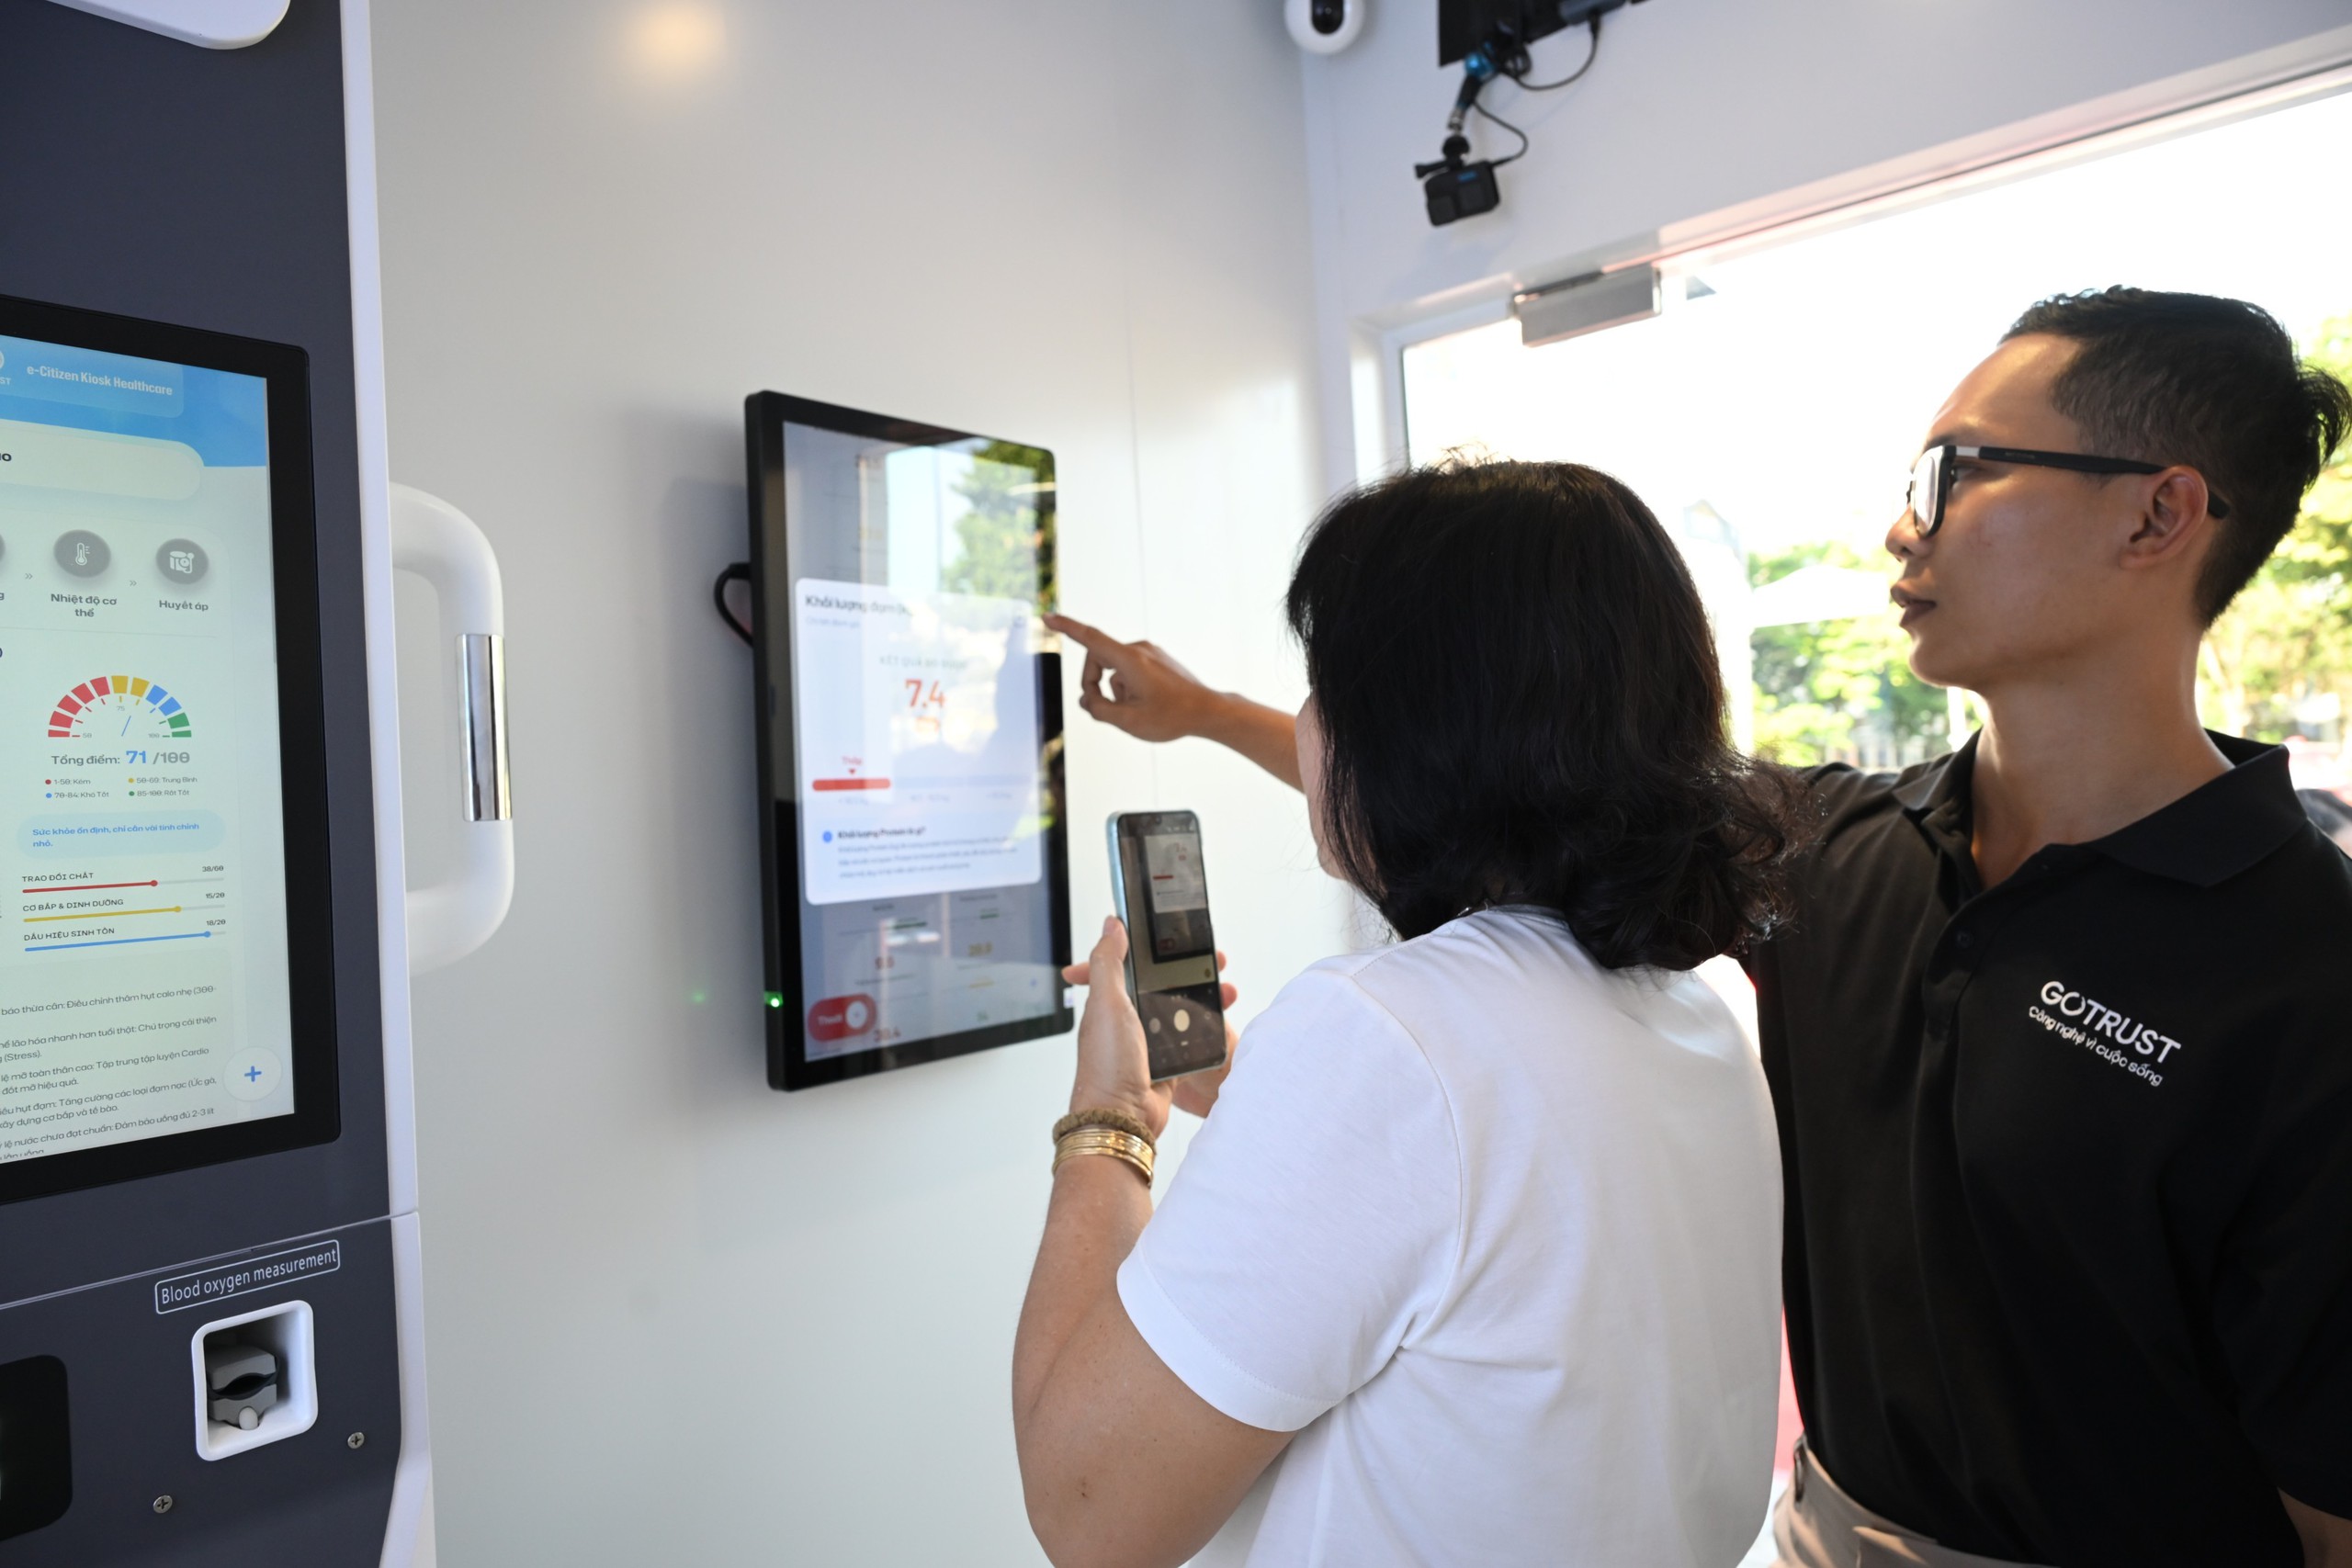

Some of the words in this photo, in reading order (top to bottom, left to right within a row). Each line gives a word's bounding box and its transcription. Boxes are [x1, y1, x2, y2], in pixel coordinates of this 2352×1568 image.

[27, 366, 79, 382] e-Citizen
[80, 372, 111, 387] Kiosk
[113, 377, 173, 396] Healthcare
[51, 593, 84, 604] Nhiệt
[85, 595, 100, 606] độ
[158, 600, 193, 611] Huyết
[194, 602, 209, 612] áp
[74, 607, 95, 617] thể
[905, 678, 945, 708] 7.4
[51, 754, 84, 767] Tổng
[86, 754, 120, 764] điểm:
[126, 750, 146, 764] 71
[153, 751, 190, 765] /100
[32, 828, 51, 836] Sức
[66, 901, 91, 909] DINH
[71, 929, 95, 937] SINH
[22, 1005, 44, 1013] thừa
[46, 1002, 65, 1010] cân:
[141, 993, 154, 1001] hụt
[156, 990, 175, 998] calo
[175, 988, 192, 997] nhẹ
[28, 1036, 47, 1045] hóa
[48, 1032, 78, 1043] nhanh
[158, 1021, 181, 1030] trọng
[196, 1016, 217, 1025] thiện
[2041, 980, 2182, 1064] GOTRUST
[4, 1050, 42, 1063] (Stress).
[2029, 1006, 2057, 1031] Công
[2054, 1021, 2086, 1045] nghệ
[2086, 1036, 2098, 1051] vì
[2096, 1044, 2128, 1067] cuộc
[2128, 1062, 2164, 1087] sống
[1, 1074, 9, 1082] lệ
[29, 1069, 51, 1078] toàn
[52, 1066, 74, 1076] thân
[96, 1060, 114, 1069] Tập
[116, 1057, 140, 1066] trung
[141, 1055, 155, 1064] tập
[156, 1052, 181, 1061] luyện
[181, 1047, 209, 1057] Cardio
[38, 1081, 58, 1090] hiệu
[15, 1105, 31, 1113] hụt
[59, 1098, 84, 1107] Tăng
[85, 1092, 114, 1103] cường
[115, 1089, 131, 1099] các
[132, 1087, 148, 1096] loại
[149, 1084, 170, 1093] đạm
[17, 1117, 41, 1126] dựng
[99, 1105, 119, 1113] bào.
[14, 1137, 39, 1146] nước
[40, 1134, 65, 1143] chưa
[66, 1130, 82, 1139] đạt
[192, 1109, 206, 1118] 2-3
[162, 1280, 200, 1304] Blood
[203, 1271, 251, 1294] oxygen
[254, 1248, 337, 1281] measurement
